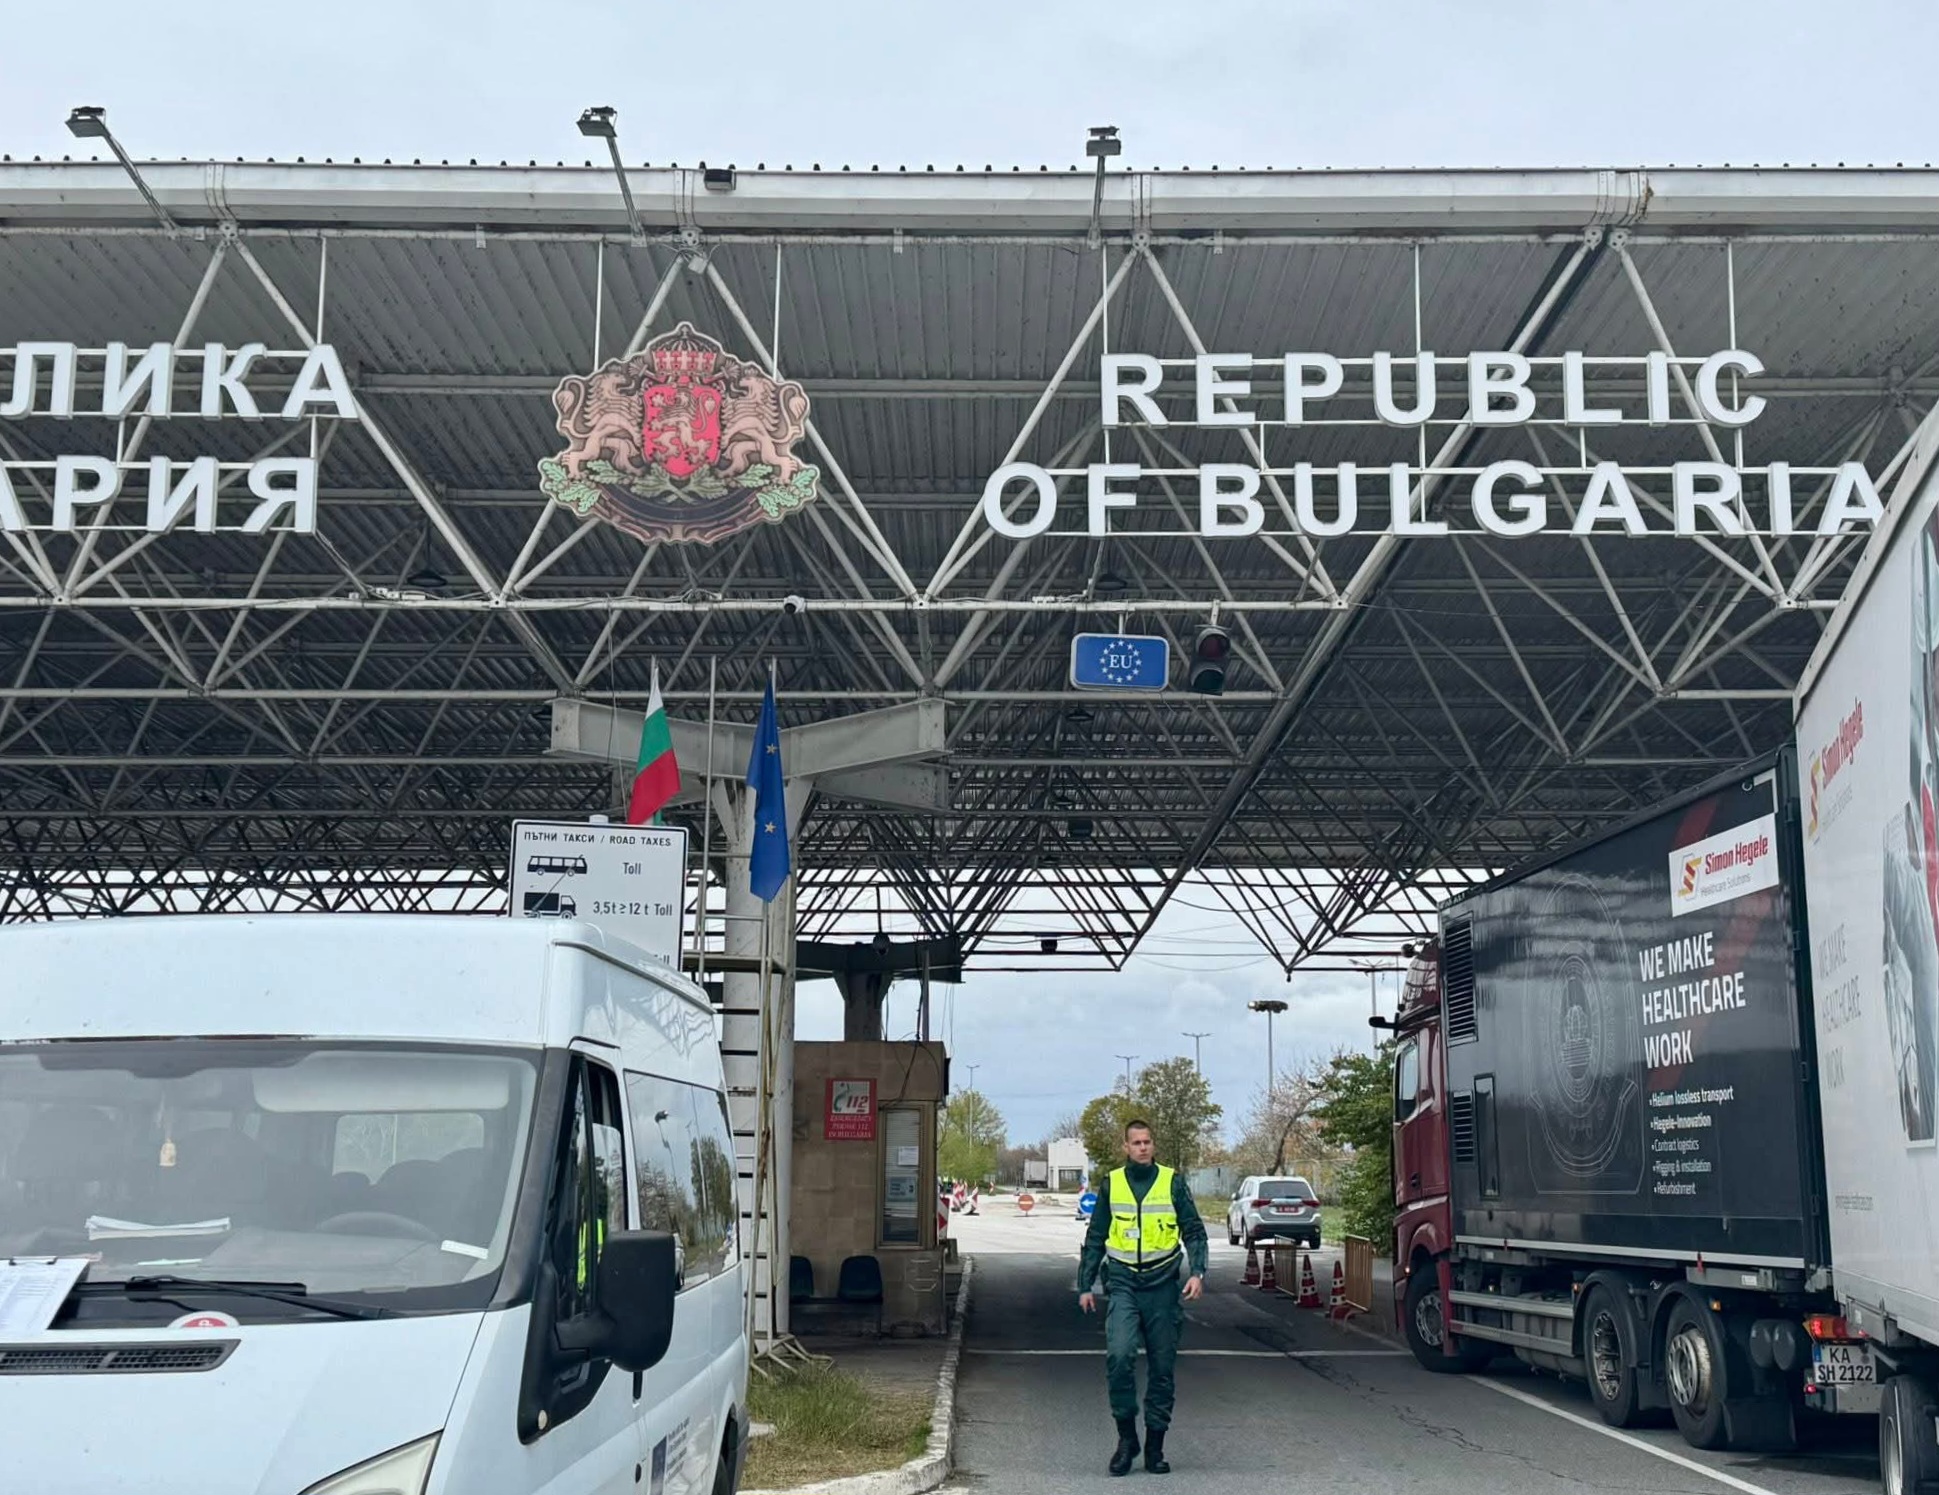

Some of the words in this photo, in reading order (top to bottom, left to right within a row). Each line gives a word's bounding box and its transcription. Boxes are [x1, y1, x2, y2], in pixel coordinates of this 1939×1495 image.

[1101, 350, 1767, 427] REPUBLIC
[983, 462, 1142, 540] OF
[1199, 460, 1886, 540] BULGARIA
[1109, 654, 1133, 669] EU
[524, 831, 558, 841] ПЪТНИ
[563, 833, 595, 843] ТАКСИ
[609, 835, 636, 845] ROAD
[640, 836, 671, 847] TAXES
[1705, 850, 1734, 875] Simon
[1735, 835, 1768, 866] Hegele
[621, 862, 641, 875] Toll
[654, 903, 673, 916] Toll
[1639, 945, 1665, 982] WE
[1667, 931, 1715, 975] MAKE
[1642, 971, 1747, 1025] HEALTHCARE
[1643, 1029, 1694, 1069] WORK
[846, 1096, 868, 1108] 112
[1652, 1092, 1675, 1107] Helium
[1675, 1089, 1700, 1105] lossless
[1701, 1085, 1734, 1106] transport
[1829, 1347, 1851, 1364] KA
[1818, 1365, 1836, 1381] SH
[1840, 1365, 1873, 1381] 2122
